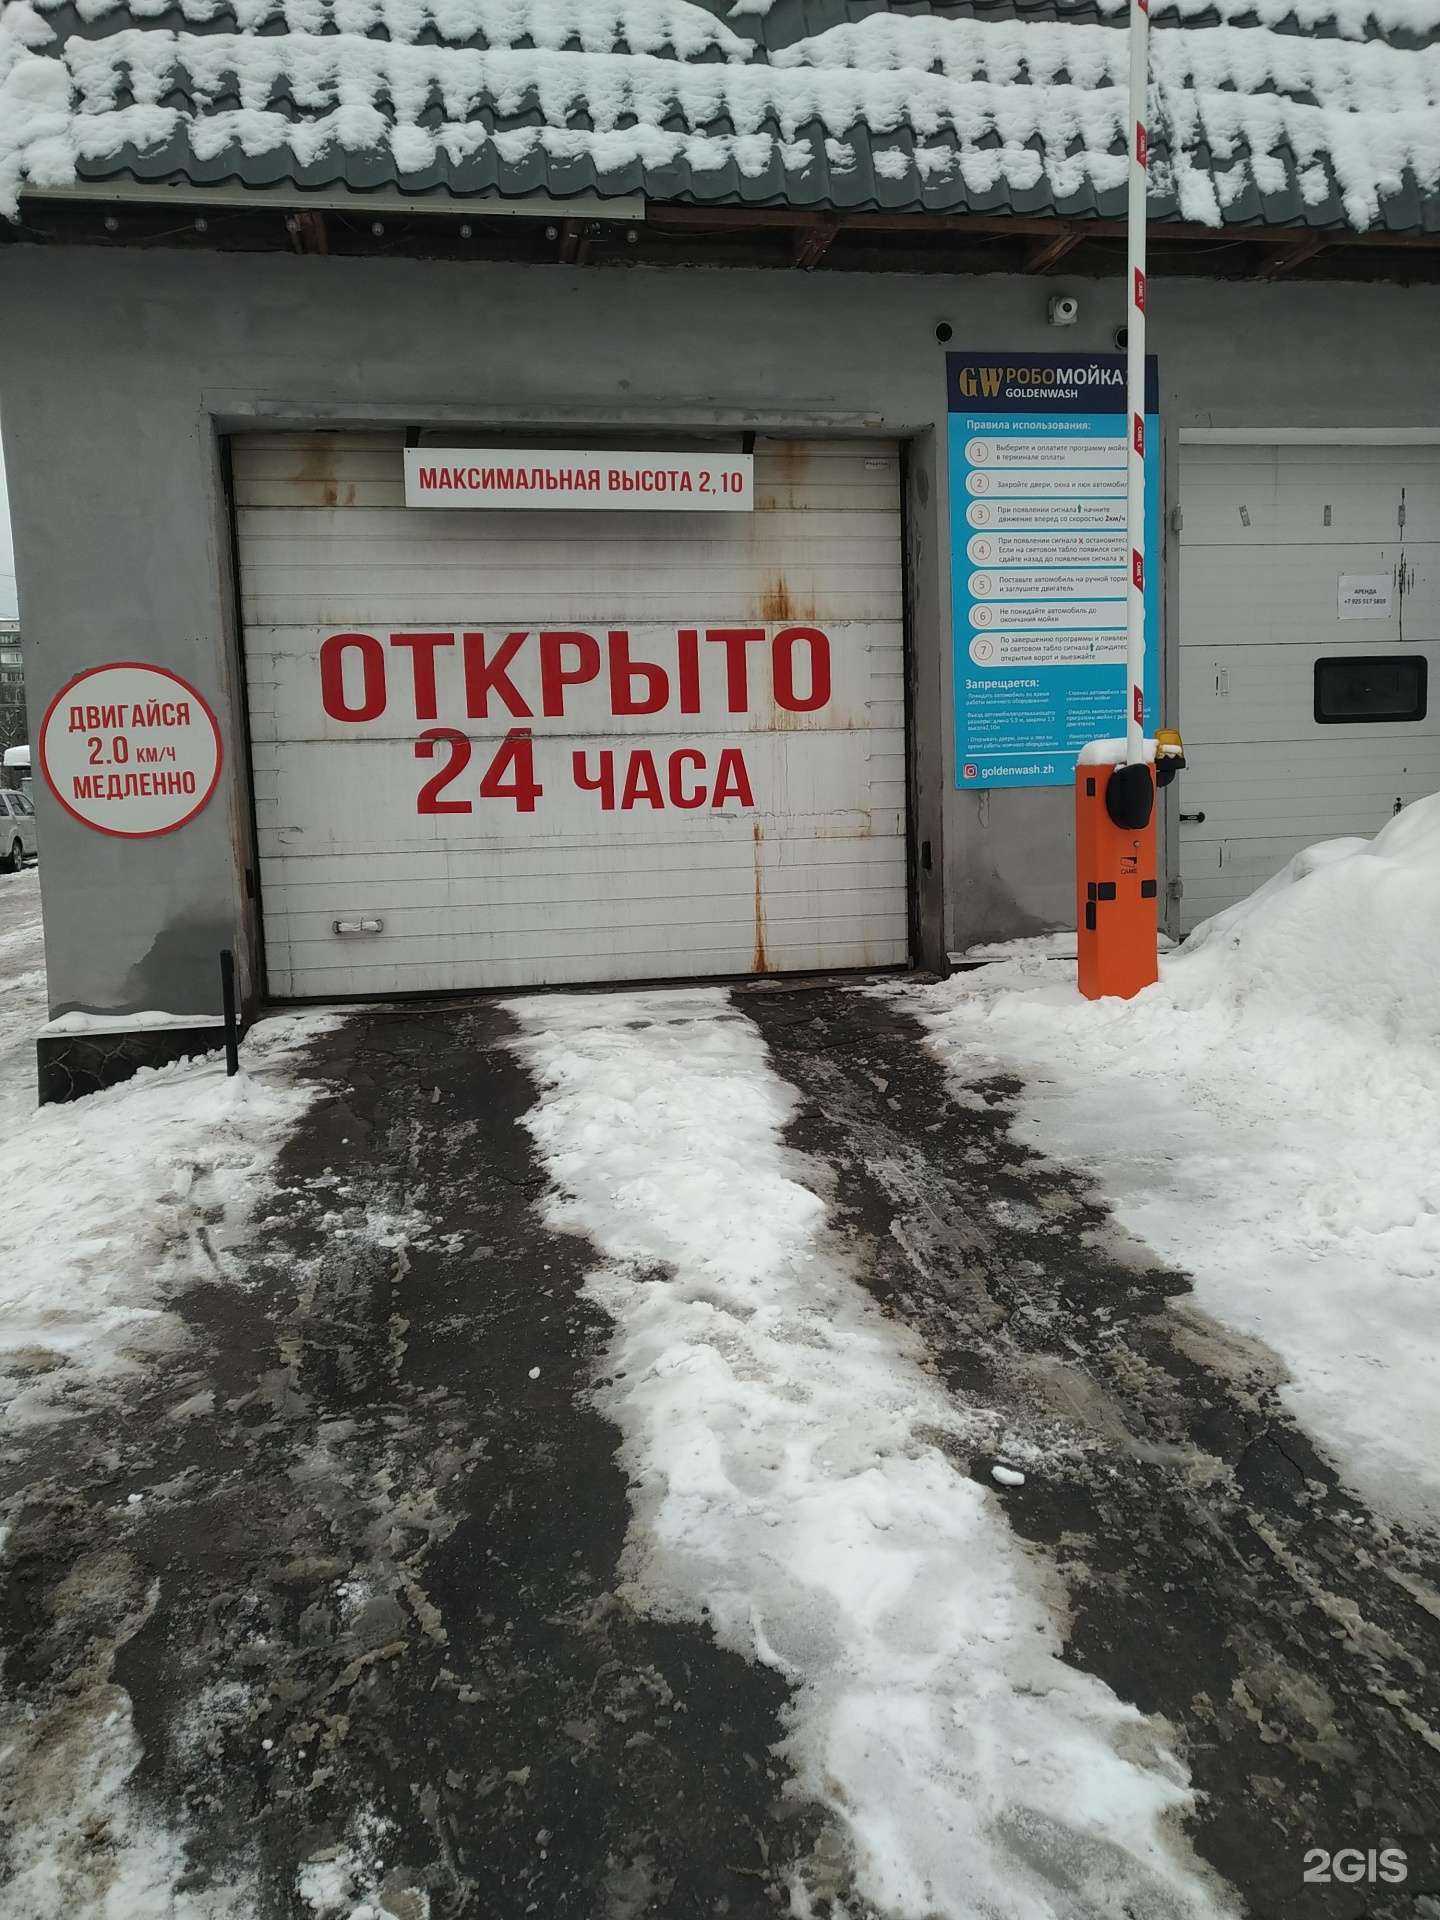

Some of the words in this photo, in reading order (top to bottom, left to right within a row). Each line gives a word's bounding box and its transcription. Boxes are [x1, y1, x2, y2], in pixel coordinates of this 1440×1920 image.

[959, 367, 1003, 398] GW
[1005, 388, 1078, 398] GOLDENWASH
[966, 420, 1010, 431] Правила
[1012, 422, 1092, 431] использования:
[418, 467, 601, 490] МАКСИМАЛЬНАЯ
[607, 469, 693, 491] ВЫСОТА
[698, 471, 744, 495] 2,10
[997, 480, 1028, 488] Закройте
[998, 555, 1021, 563] сдайте
[1034, 575, 1074, 583] автомобиль
[1085, 575, 1109, 584] ручной
[1041, 585, 1074, 593] двигатель
[1010, 607, 1046, 615] покидайте
[1043, 644, 1062, 652] табло
[319, 627, 831, 723] ОТКРЫТО
[965, 678, 1040, 690] Запрещается:
[68, 699, 190, 733] ДВИГАЙСЯ
[87, 736, 128, 765] 2.0
[413, 727, 543, 815] 24
[572, 748, 755, 811] ЧАСА
[982, 764, 1055, 778] goldenwash.zh
[72, 770, 196, 800] МЕДЛЕННО
